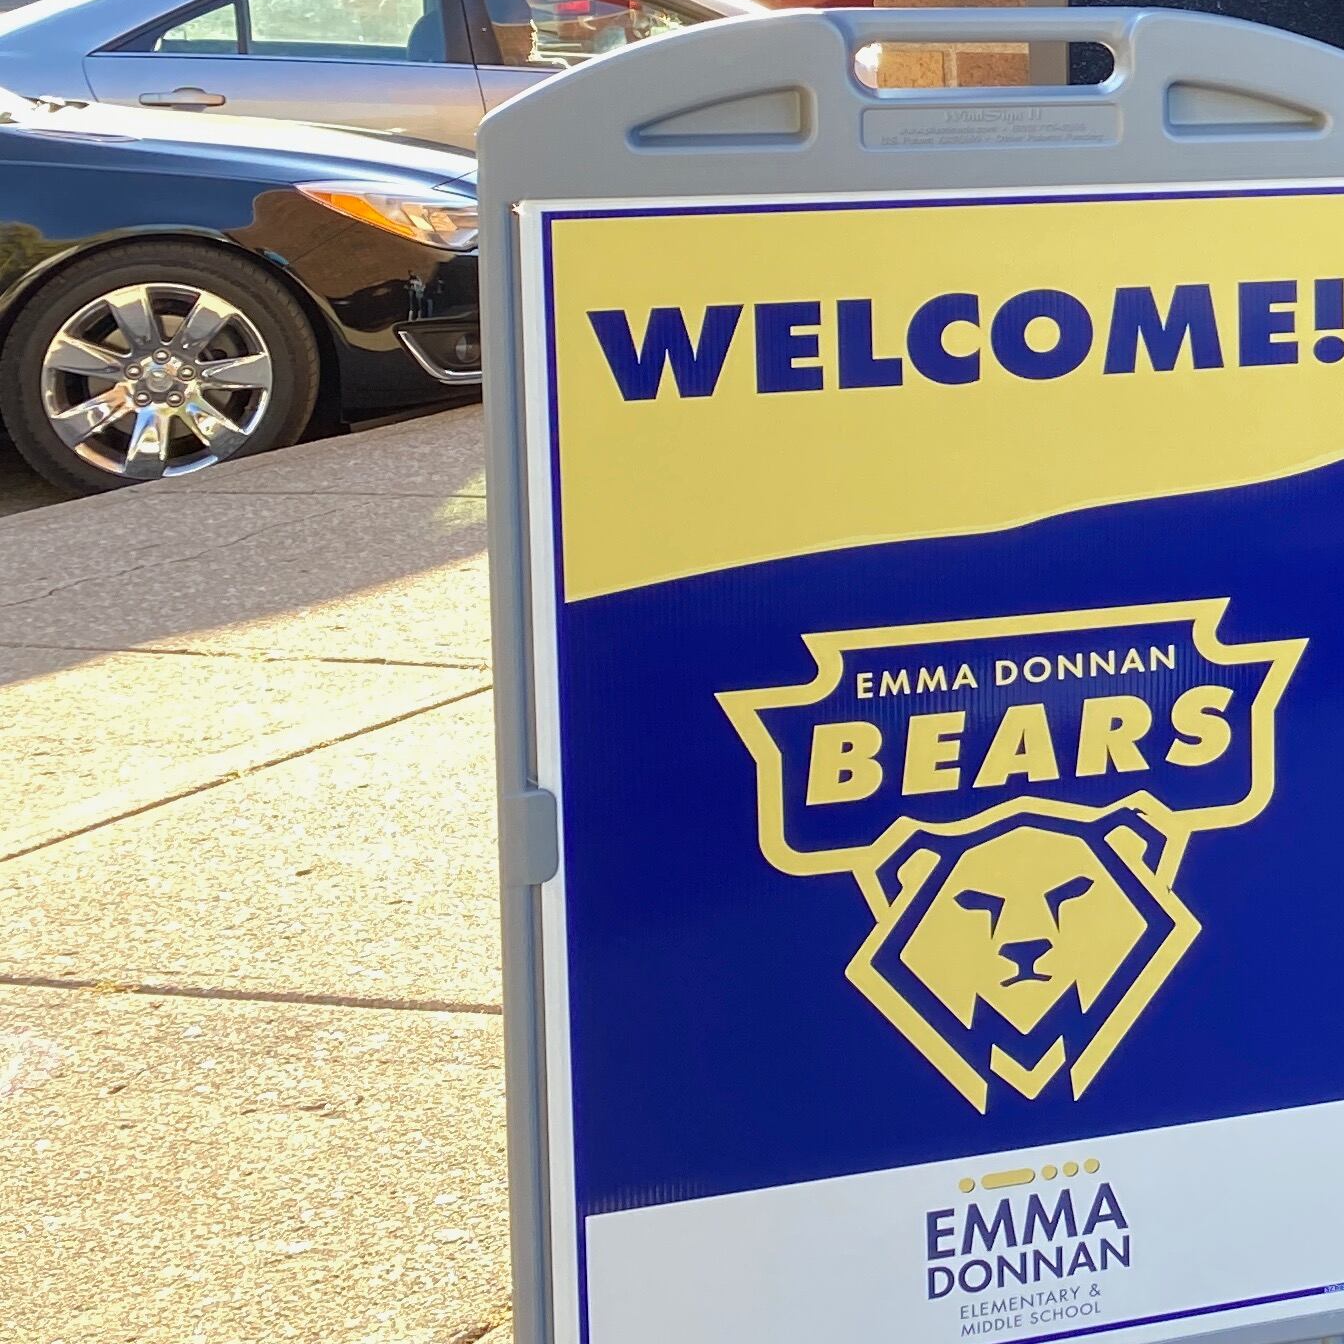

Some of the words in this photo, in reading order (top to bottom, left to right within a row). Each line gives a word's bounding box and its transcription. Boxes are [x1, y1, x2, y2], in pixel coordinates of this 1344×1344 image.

[857, 664, 978, 699] EMMA
[995, 644, 1176, 687] DONNAN
[806, 684, 1234, 807] BEARS
[926, 1182, 1128, 1261] EMMA
[927, 1235, 1130, 1300] DONNAN
[960, 1285, 1081, 1320] ELEMENTARY
[1089, 1283, 1102, 1296] &
[960, 1314, 1023, 1337] MIDDLE
[1030, 1301, 1102, 1324] SCHOOL
